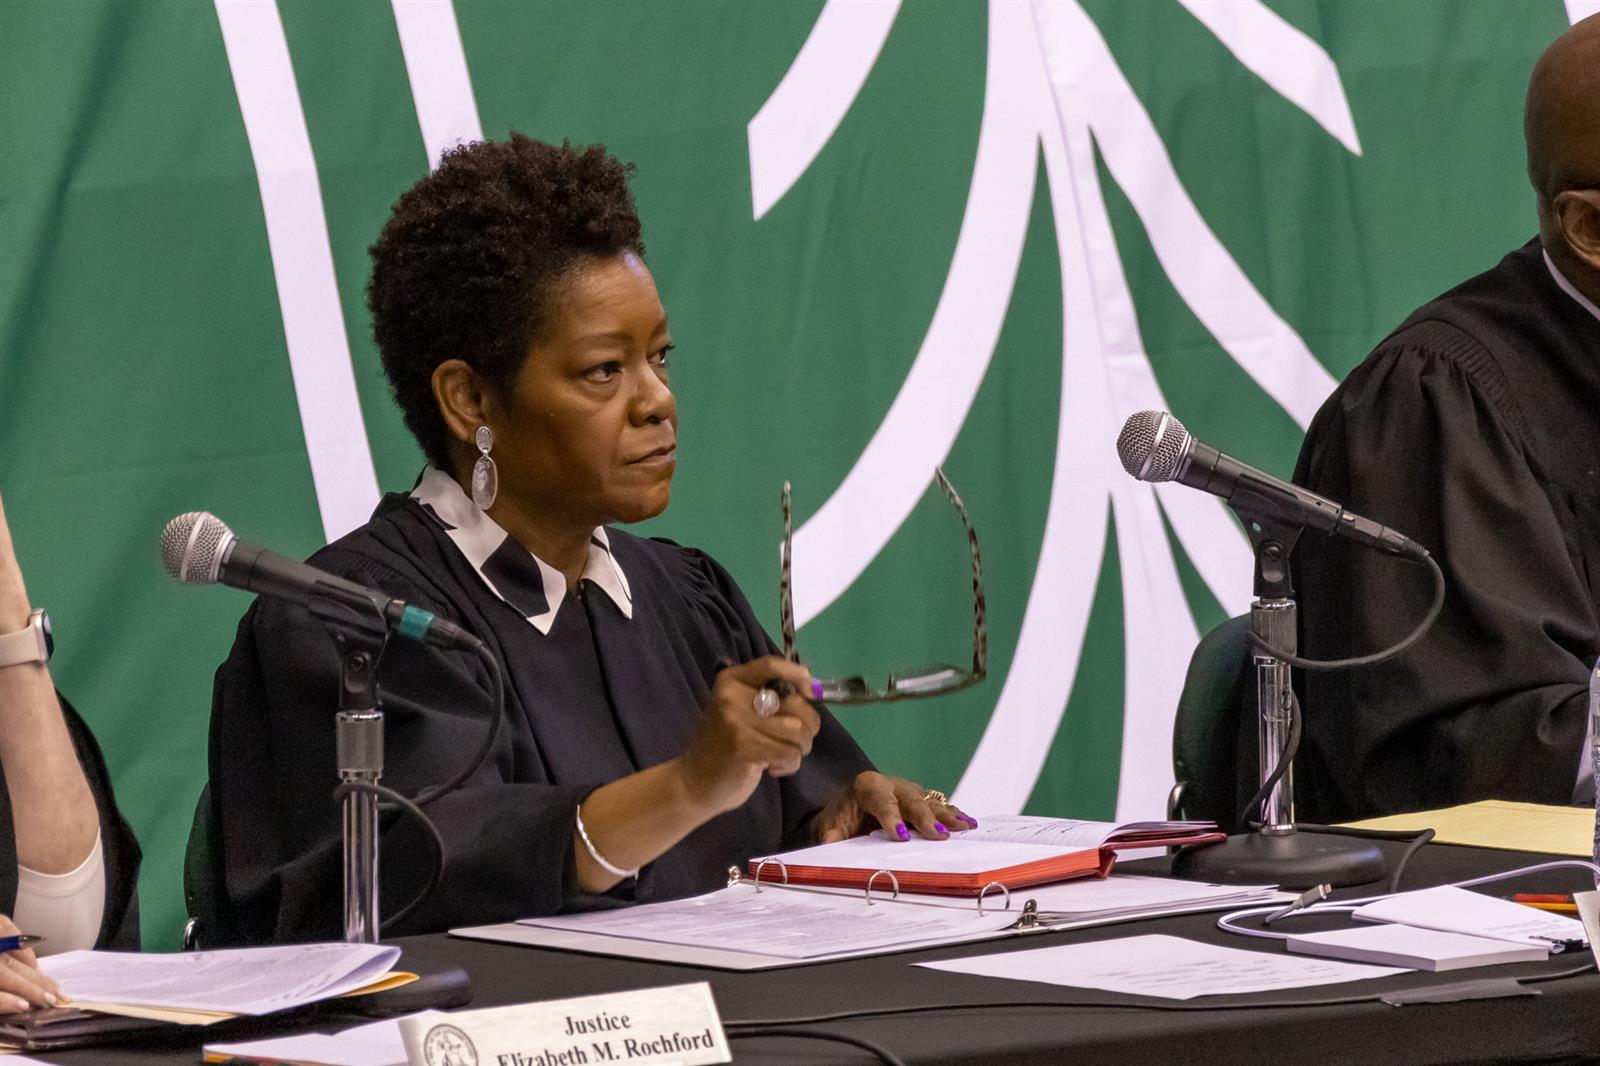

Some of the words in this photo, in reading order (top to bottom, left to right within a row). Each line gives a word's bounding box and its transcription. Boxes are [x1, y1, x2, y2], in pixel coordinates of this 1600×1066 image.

[565, 1011, 632, 1036] Justice
[592, 1041, 620, 1063] M.
[624, 1028, 715, 1059] Rochford
